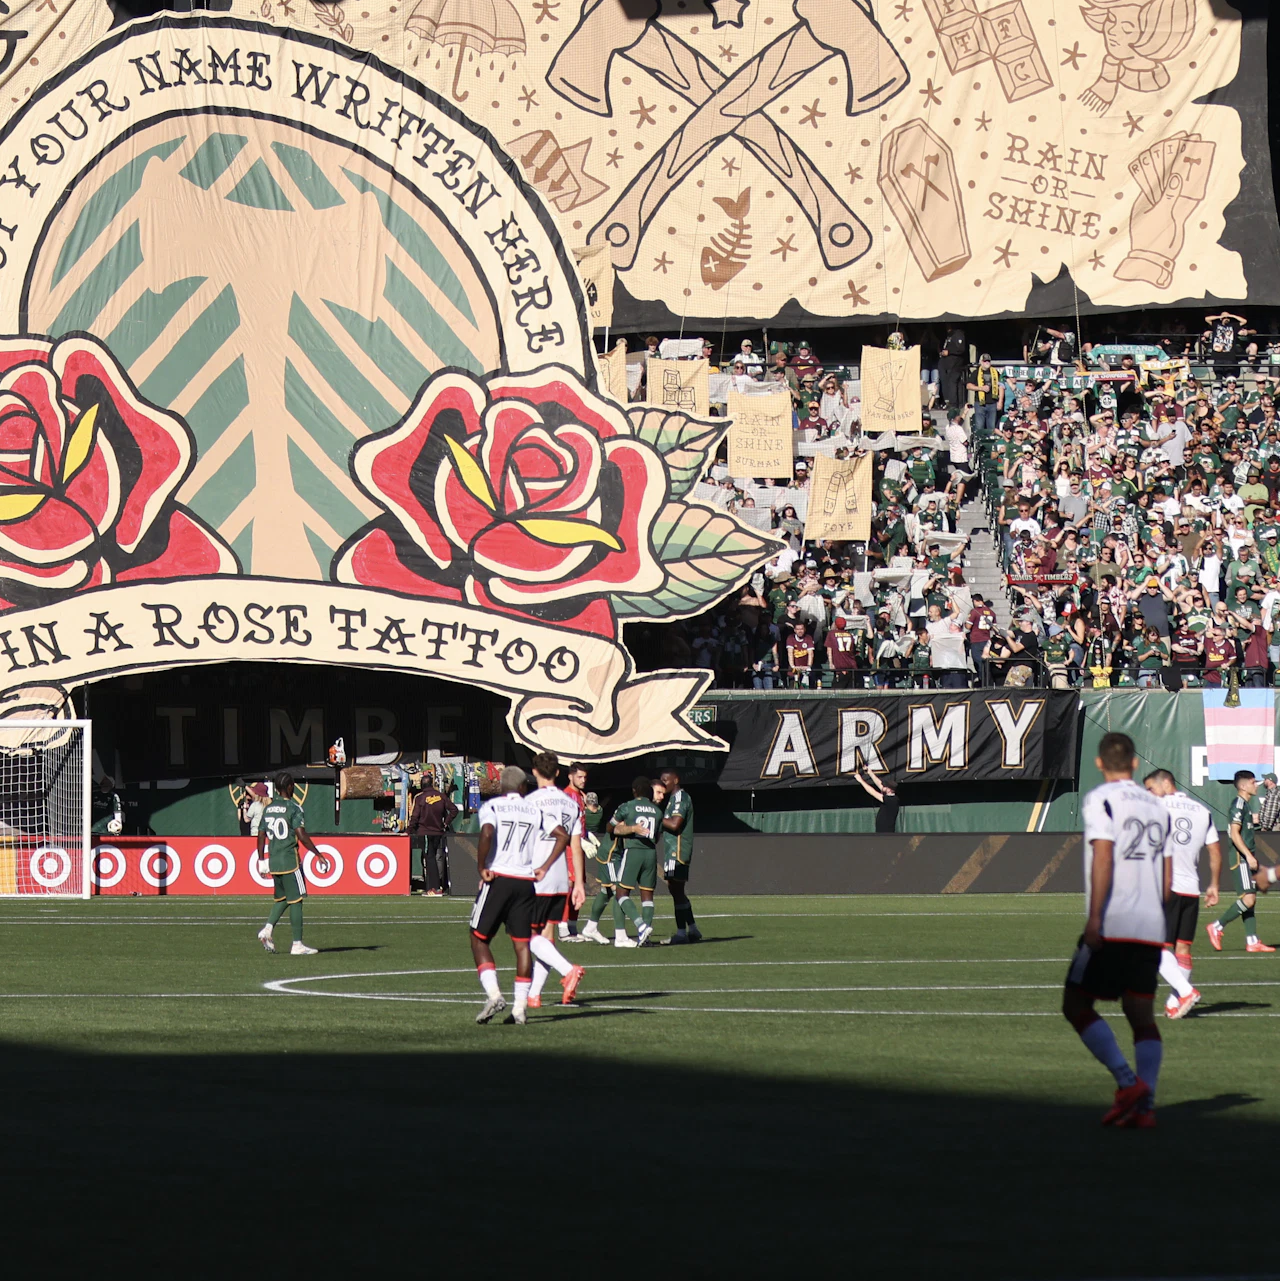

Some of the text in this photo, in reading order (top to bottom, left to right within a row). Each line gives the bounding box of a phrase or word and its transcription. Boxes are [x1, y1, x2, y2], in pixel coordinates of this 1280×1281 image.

[1003, 132, 1109, 181] RAIN
[129, 45, 272, 97] NAME
[291, 59, 504, 217] WRITTEN
[484, 215, 566, 355] HERE
[983, 191, 1101, 240] SHINE
[735, 439, 785, 451] SHINE
[735, 457, 781, 468] SURMAN
[823, 522, 854, 531] TOYE
[86, 610, 131, 655] A
[152, 600, 313, 652] ROSE
[329, 600, 582, 687] TATTOO
[836, 633, 851, 652] 17
[761, 698, 1045, 780] ARMY
[497, 804, 537, 815] BERNARD
[635, 805, 656, 815] CHARA
[265, 817, 289, 840] 30
[501, 820, 534, 853] 77
[1122, 816, 1164, 862] 29
[1172, 817, 1193, 846] 8
